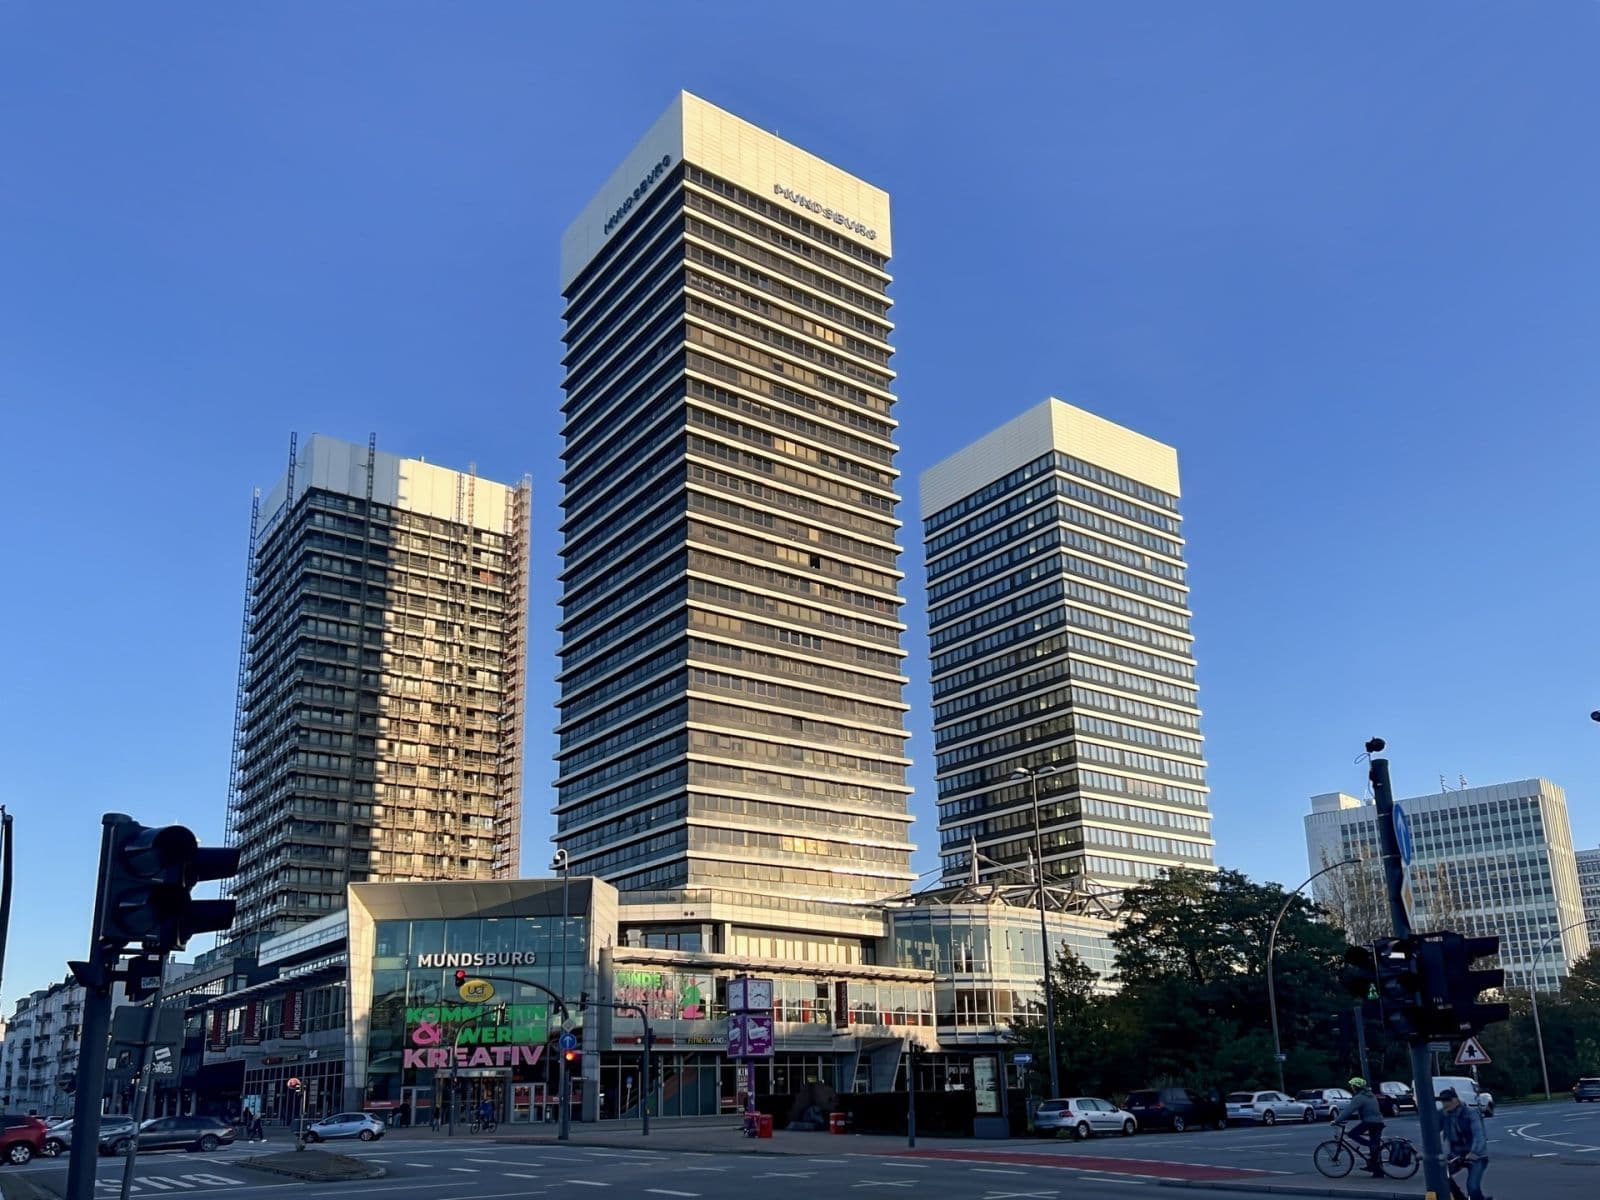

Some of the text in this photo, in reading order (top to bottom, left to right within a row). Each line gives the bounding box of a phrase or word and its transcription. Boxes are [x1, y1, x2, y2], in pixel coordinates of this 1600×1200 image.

[604, 154, 671, 235] MUNDSBURG
[773, 183, 878, 240] MUNDSBURG
[417, 951, 536, 968] MUNDSBURG
[406, 1006, 482, 1023] KOMM
[403, 1045, 544, 1069] KREATIV
